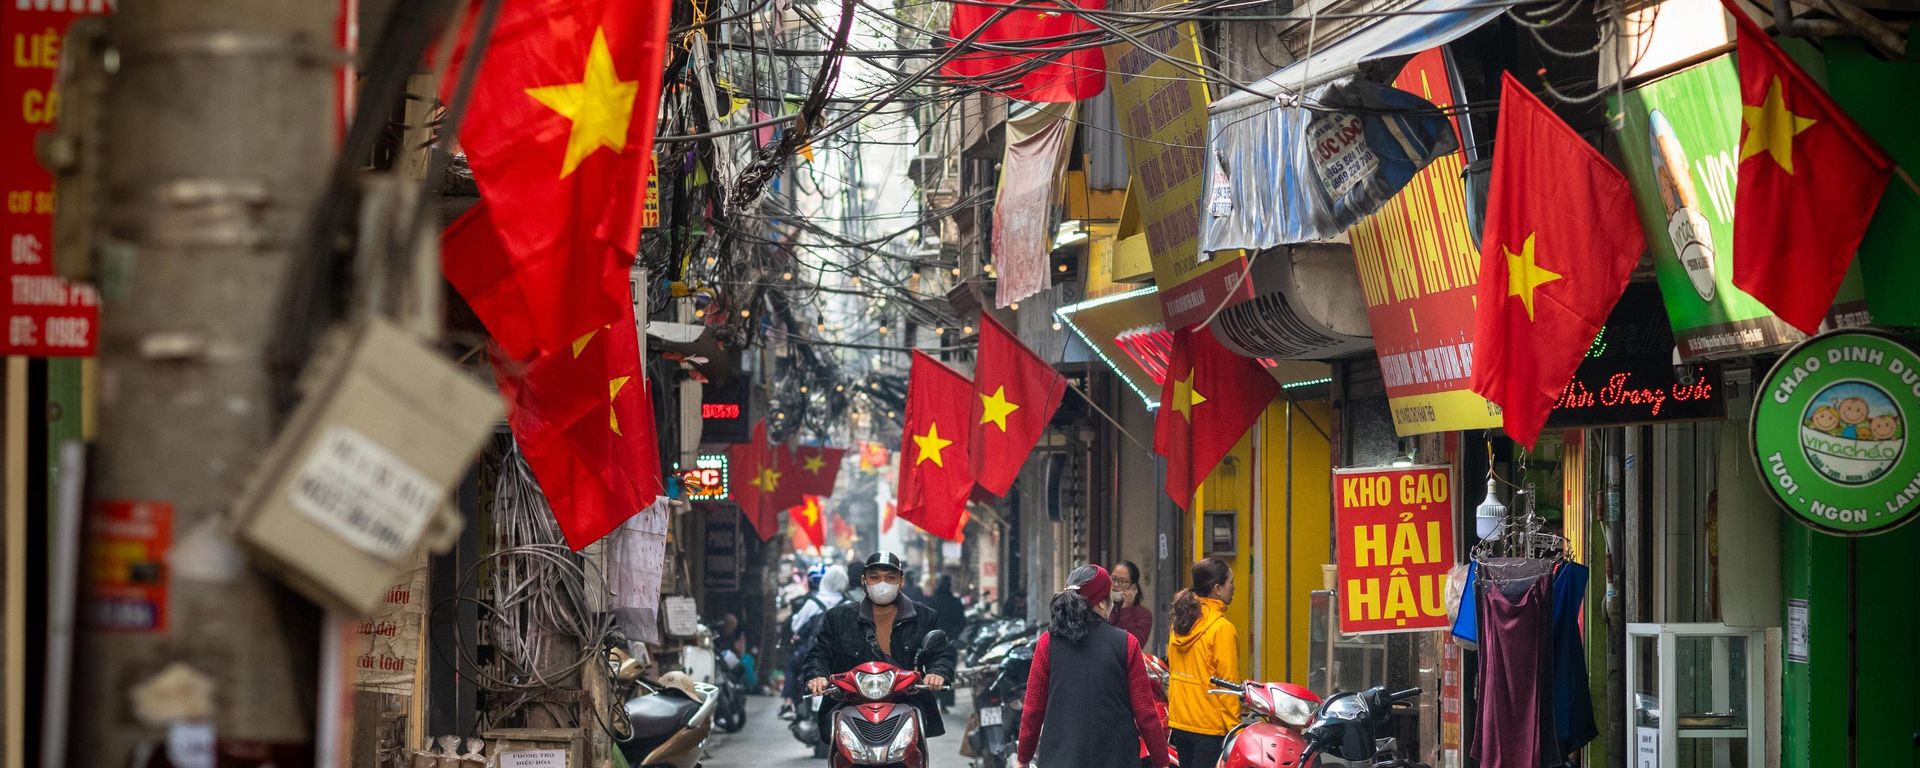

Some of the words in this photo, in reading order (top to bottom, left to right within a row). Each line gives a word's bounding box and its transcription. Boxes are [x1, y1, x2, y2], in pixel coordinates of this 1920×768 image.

[1827, 347, 1884, 366] DINH
[1343, 475, 1391, 508] KHO
[1400, 473, 1448, 510] GẠO
[1810, 500, 1867, 523] NGON
[1354, 511, 1441, 567] HẢI
[1347, 567, 1448, 626] HẬU
